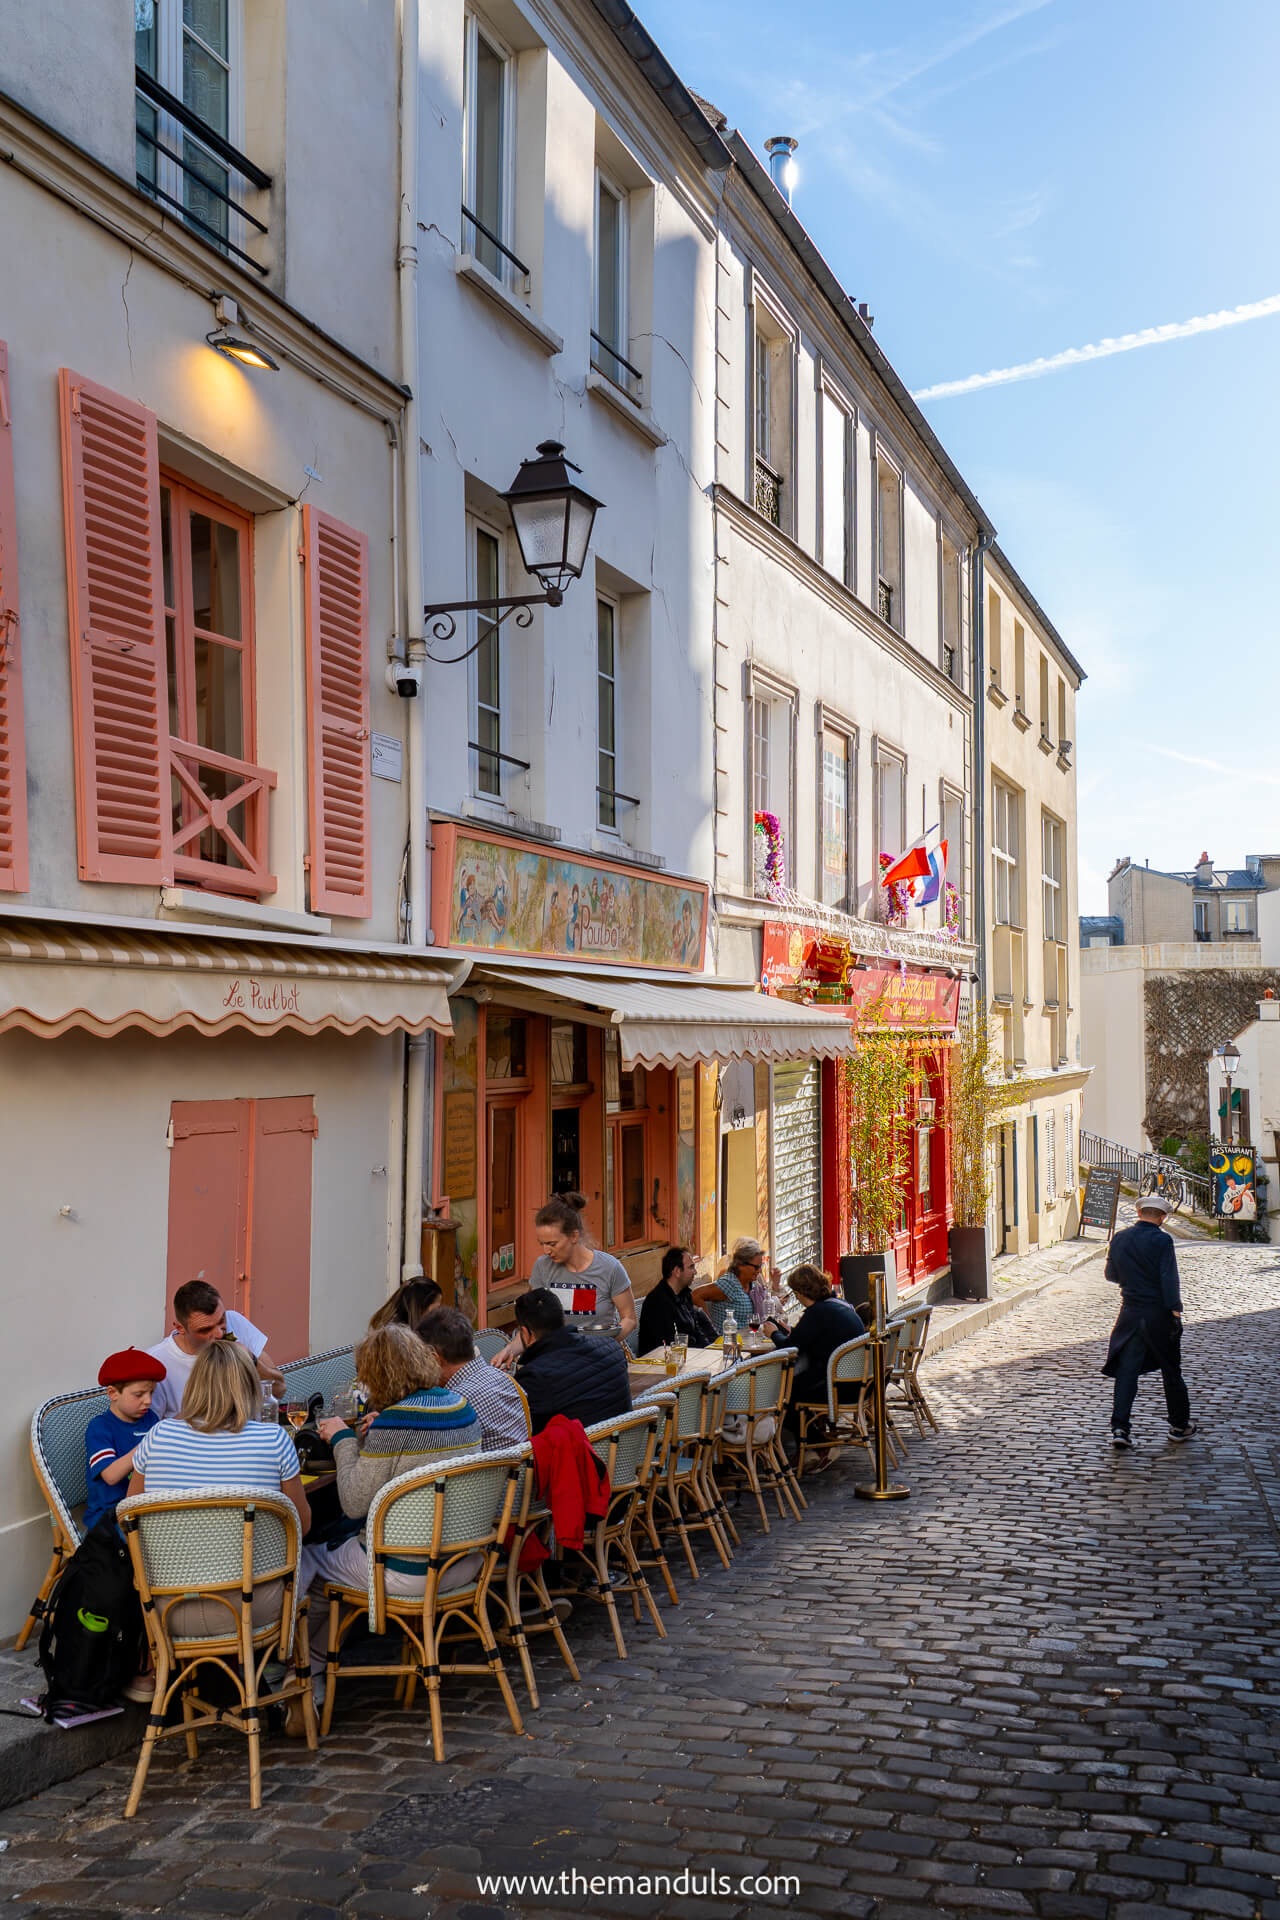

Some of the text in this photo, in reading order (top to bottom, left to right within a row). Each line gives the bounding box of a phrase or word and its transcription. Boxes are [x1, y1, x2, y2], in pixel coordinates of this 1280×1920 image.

[223, 979, 300, 1012] Le Poulbot
[1211, 1146, 1253, 1158] RESTAURANT
